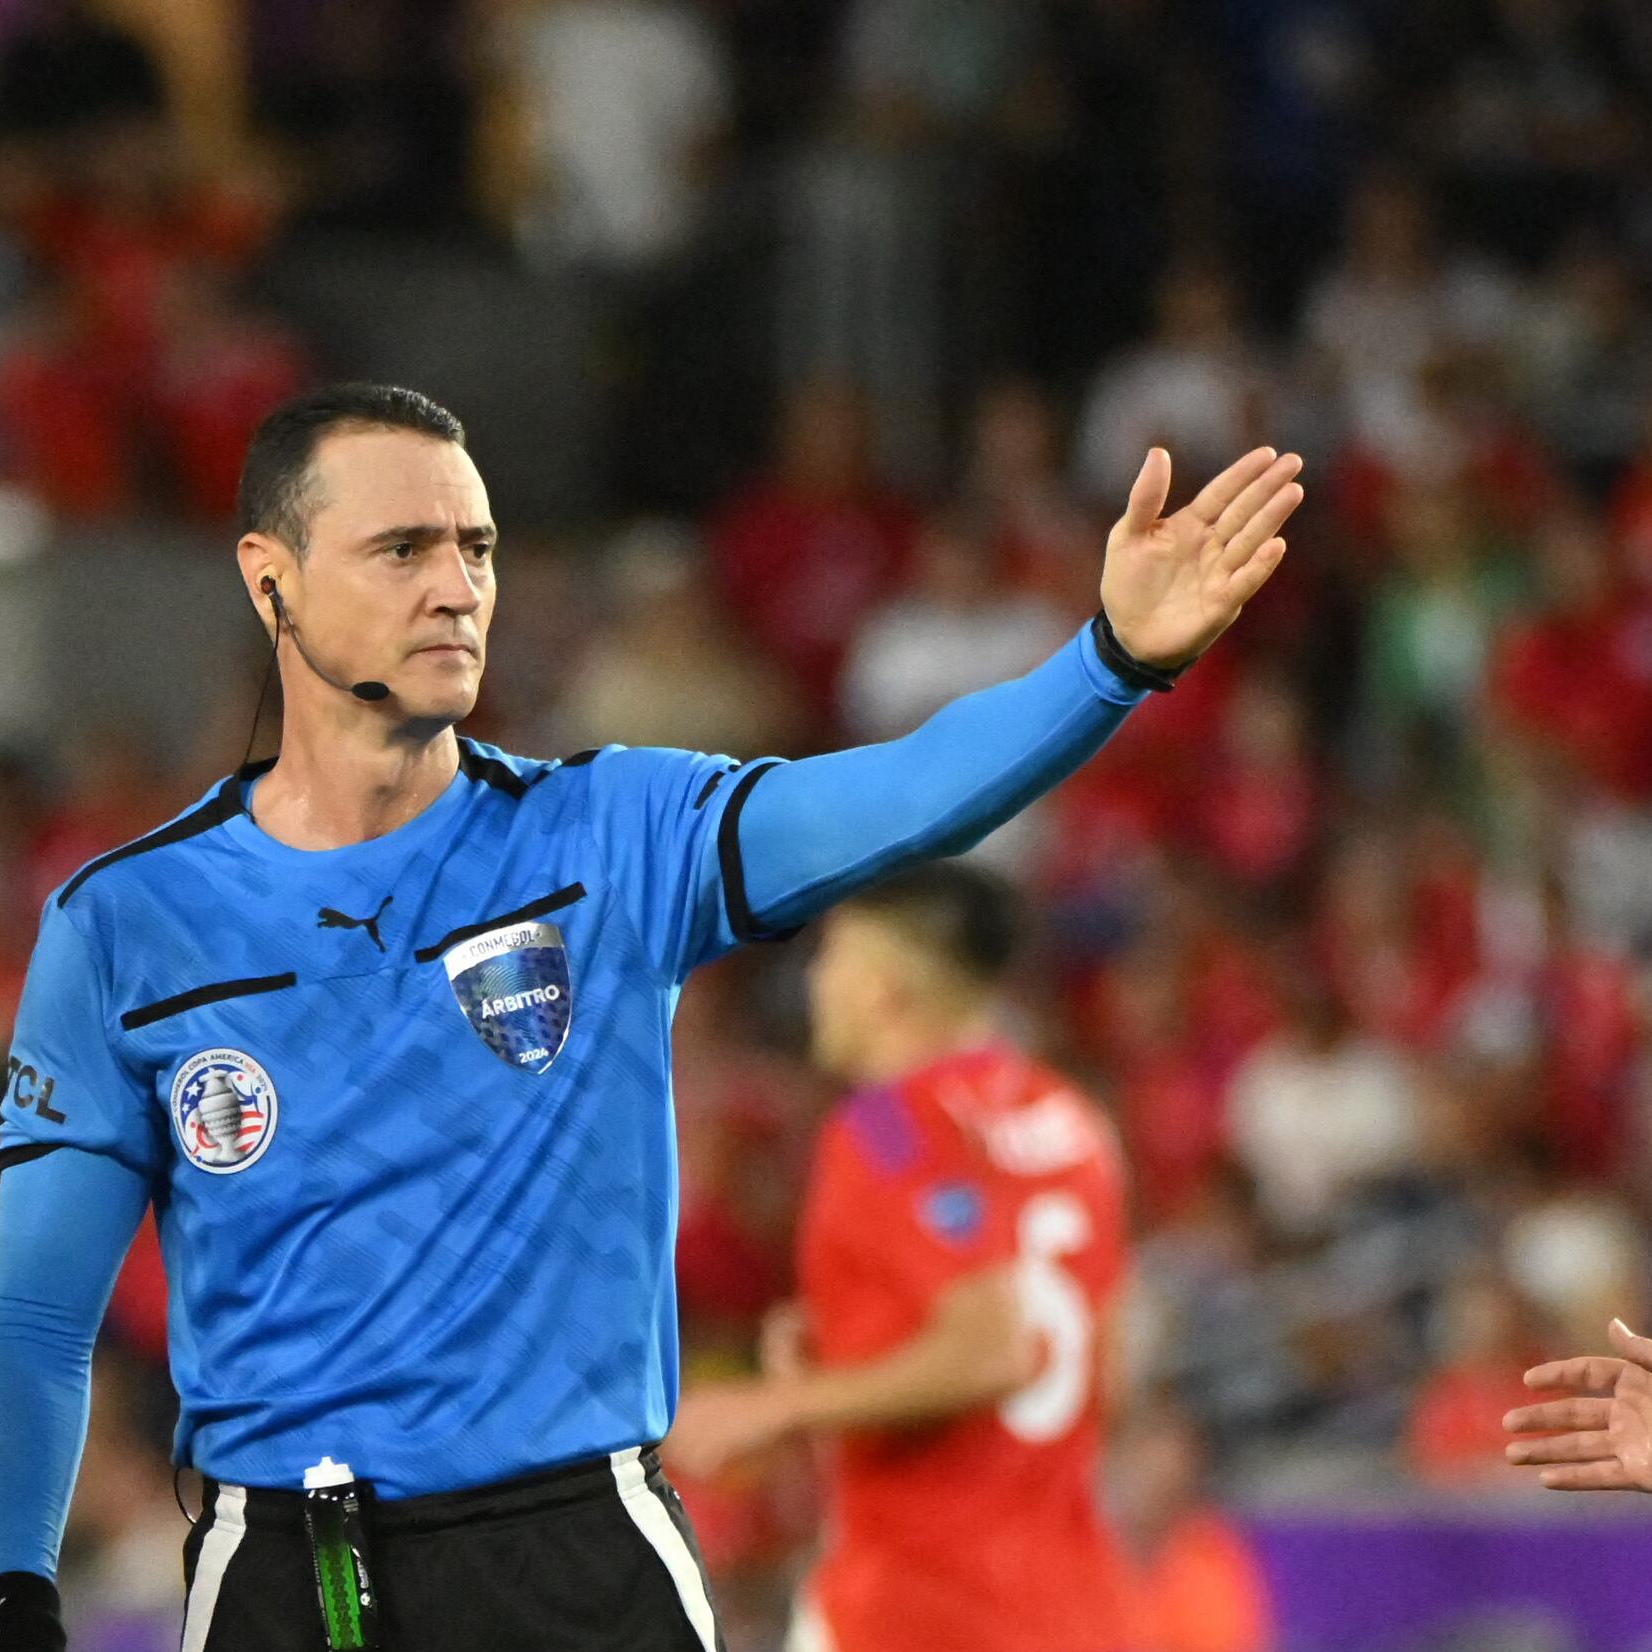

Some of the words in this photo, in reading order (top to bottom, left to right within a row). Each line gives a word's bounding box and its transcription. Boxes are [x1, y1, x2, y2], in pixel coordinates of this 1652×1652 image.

[469, 929, 535, 958] CONMEBOL
[481, 984, 560, 1019] ÁRBITRO
[210, 1053, 244, 1064] AMERICA
[518, 1048, 549, 1064] 2024
